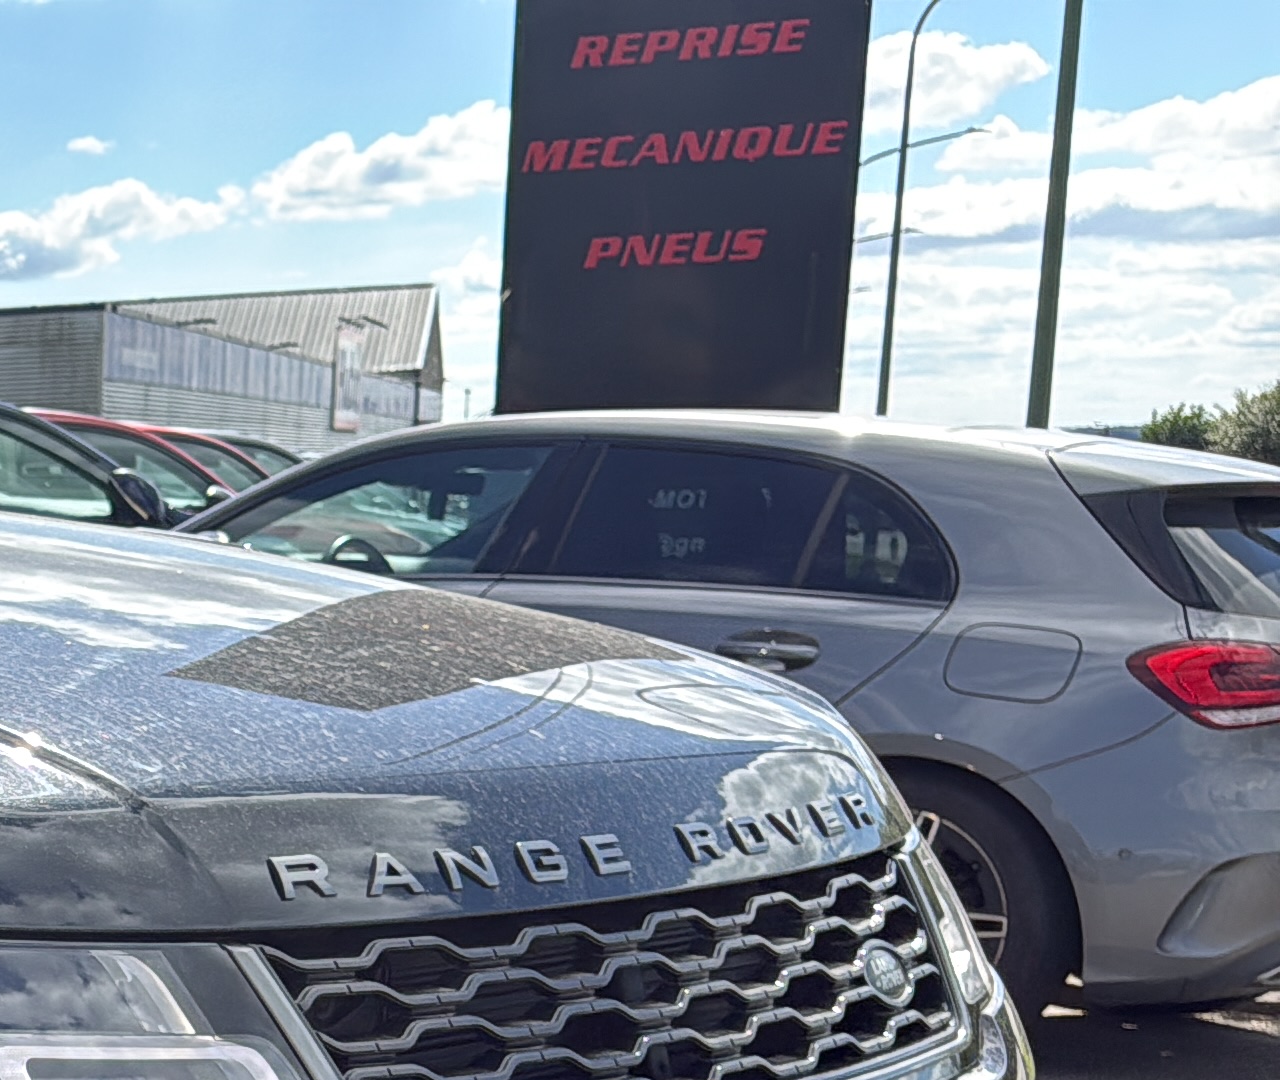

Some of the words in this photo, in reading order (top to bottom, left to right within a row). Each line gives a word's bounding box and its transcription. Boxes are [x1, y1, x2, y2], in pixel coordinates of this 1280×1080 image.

[569, 18, 811, 69] REPRISE
[521, 120, 848, 173] MECANIQUE
[582, 228, 767, 270] PNEUS
[266, 834, 633, 901] RANGE
[673, 791, 875, 863] ROVER
